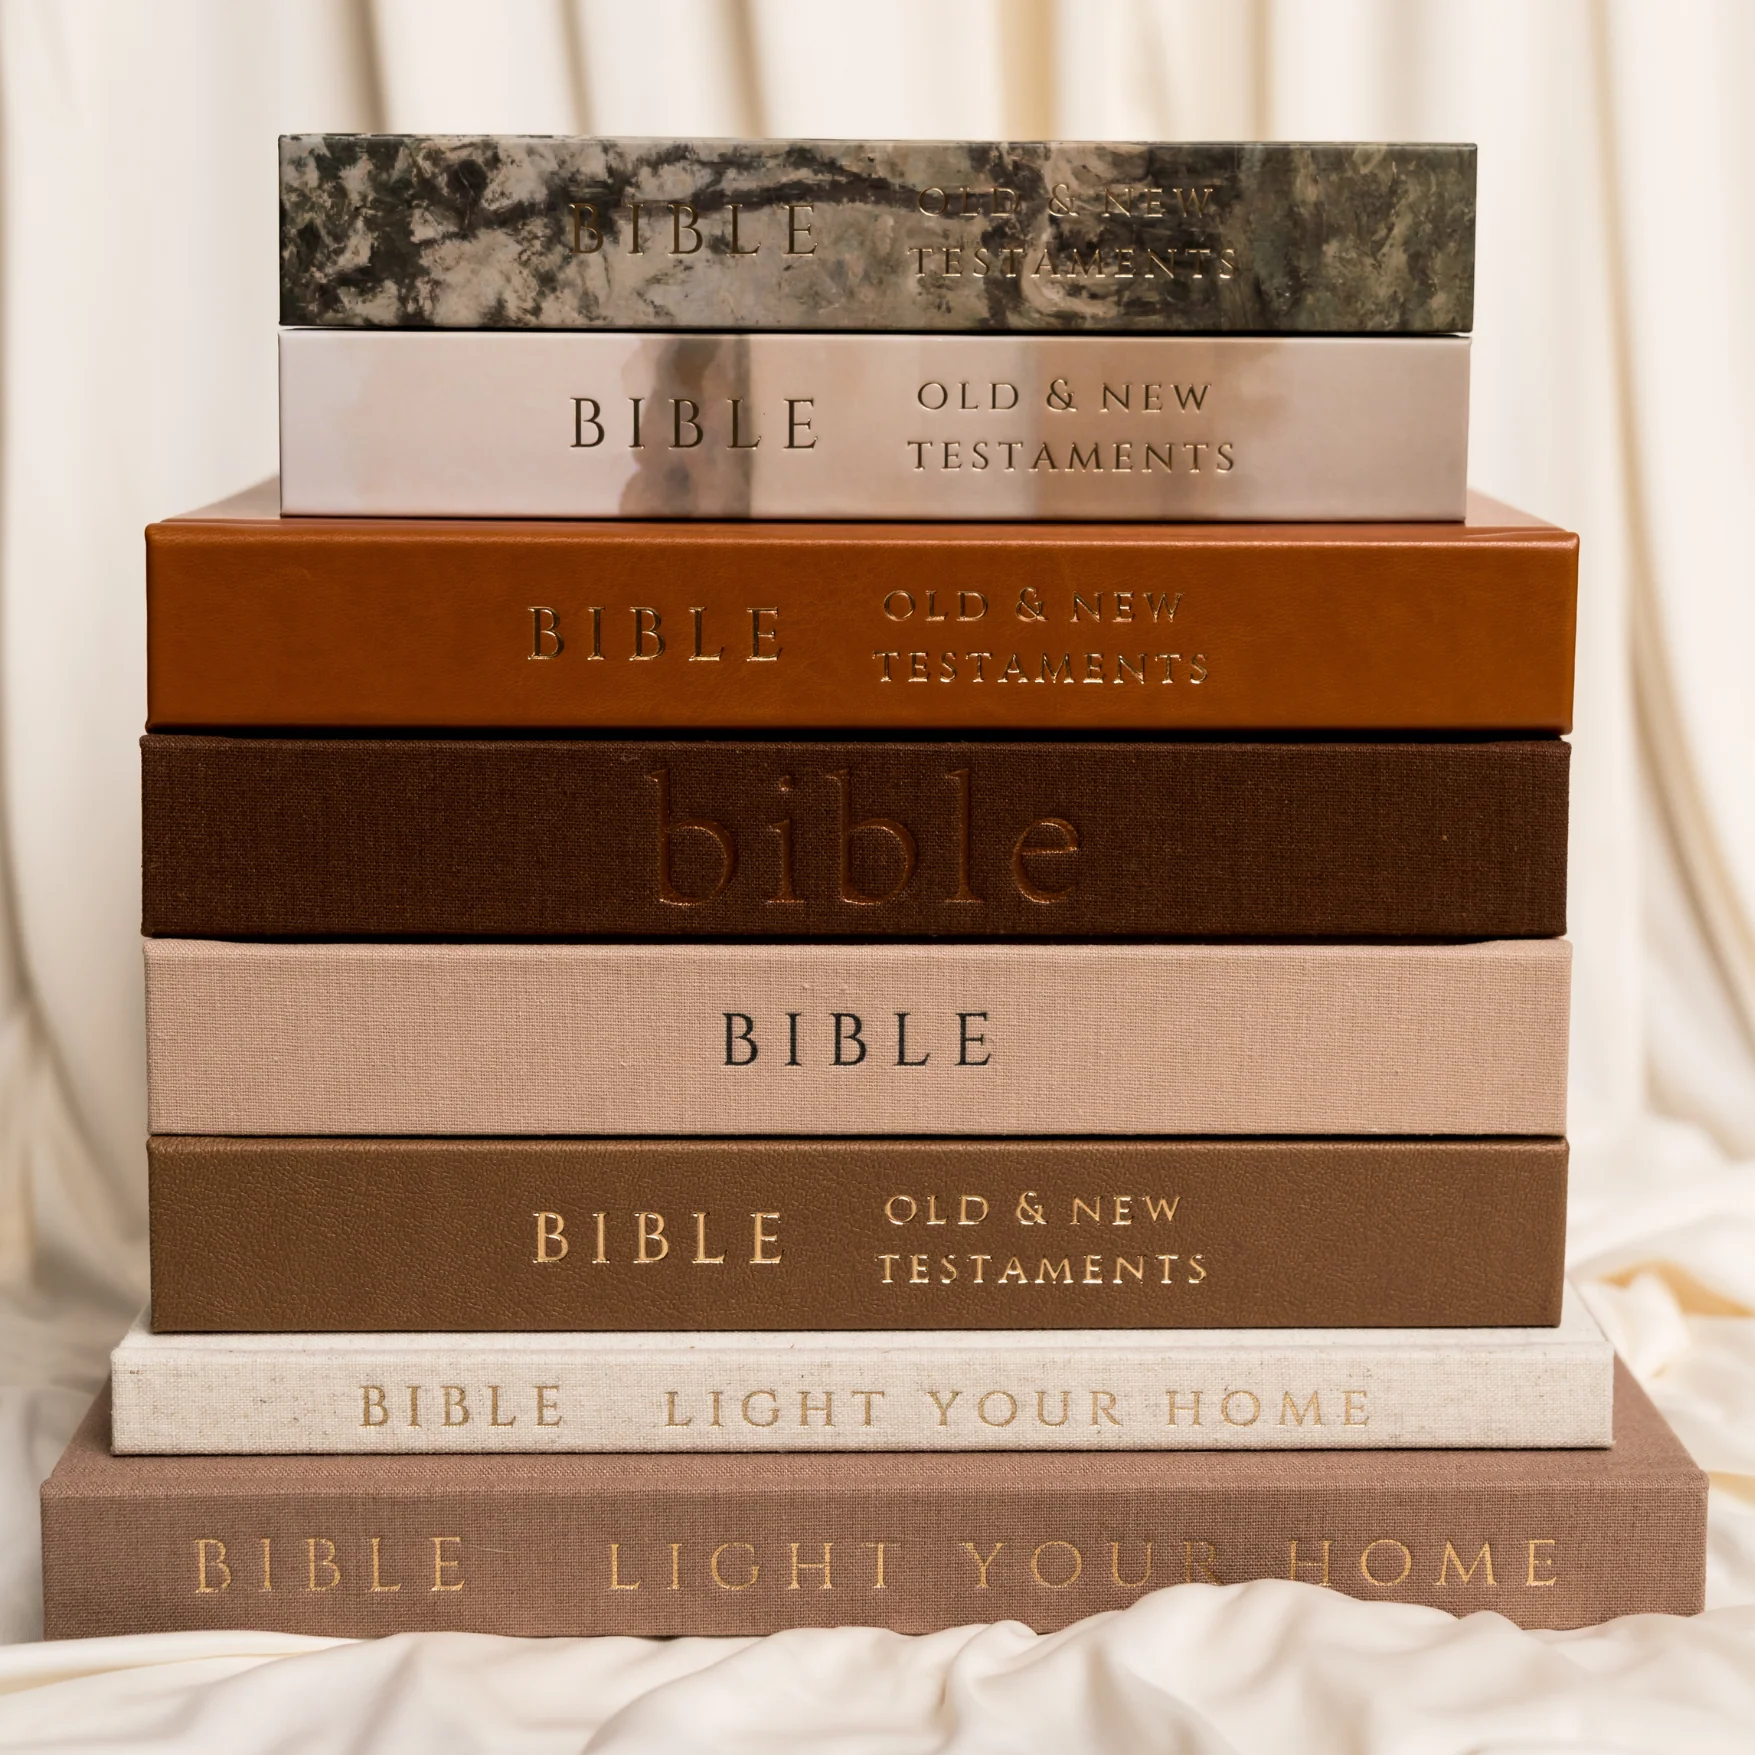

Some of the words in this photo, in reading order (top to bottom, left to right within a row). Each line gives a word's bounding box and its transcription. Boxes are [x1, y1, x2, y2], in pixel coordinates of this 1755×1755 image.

[918, 187, 1018, 217] OLD
[1048, 184, 1079, 218] &
[1102, 187, 1216, 217] NEW
[570, 203, 820, 255] BIBLE
[909, 245, 1238, 280] TESTAMENTS
[918, 382, 1018, 412] OLD
[1046, 378, 1078, 411] &
[1102, 383, 1213, 413] NEW
[570, 397, 819, 450] BIBLE
[907, 441, 1236, 474] TESTAMENTS
[883, 590, 987, 622] OLD
[1016, 587, 1048, 623] &
[1070, 592, 1184, 624] NEW
[527, 606, 782, 662] BIBLE
[872, 652, 1211, 685] TESTAMENTS
[649, 769, 1081, 907] bible
[722, 1012, 993, 1066] BIBLE
[884, 1195, 991, 1227] OLD
[1016, 1191, 1048, 1226] &
[1070, 1195, 1183, 1226] NEW
[533, 1211, 783, 1266] BIBLE
[877, 1252, 1210, 1285] TESTAMENTS
[360, 1386, 563, 1428] BIBLE
[665, 1391, 886, 1428] LIGHT
[928, 1391, 1122, 1427] YOUR
[1166, 1391, 1373, 1427] HOME
[195, 1537, 465, 1594] BIBLE
[608, 1542, 903, 1592] LIGHT
[962, 1541, 1222, 1588] YOUR
[1289, 1539, 1558, 1587] HOME
